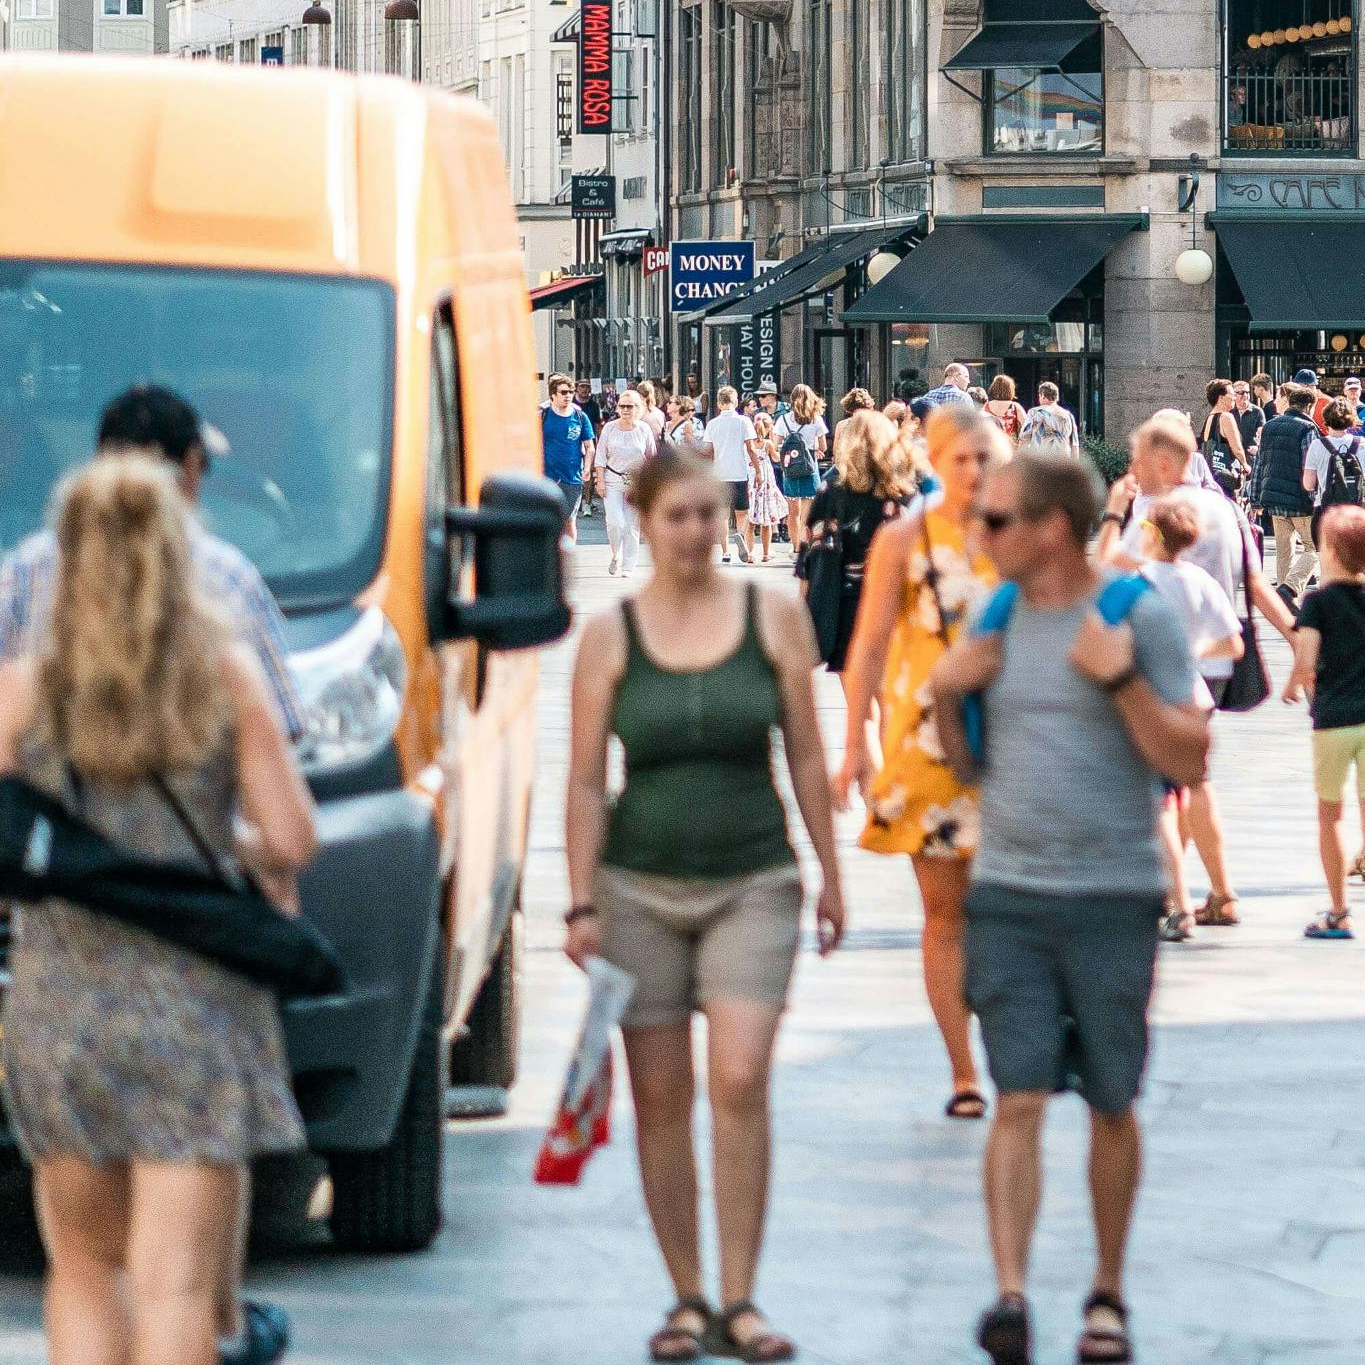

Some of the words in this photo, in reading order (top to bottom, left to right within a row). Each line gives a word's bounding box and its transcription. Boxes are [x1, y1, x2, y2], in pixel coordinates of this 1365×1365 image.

[583, 4, 610, 73] MAMMA
[583, 78, 611, 125] ROSA
[578, 179, 609, 188] Bistro
[582, 197, 605, 206] Café
[680, 255, 746, 271] MONEY
[760, 306, 774, 368] ESIGN
